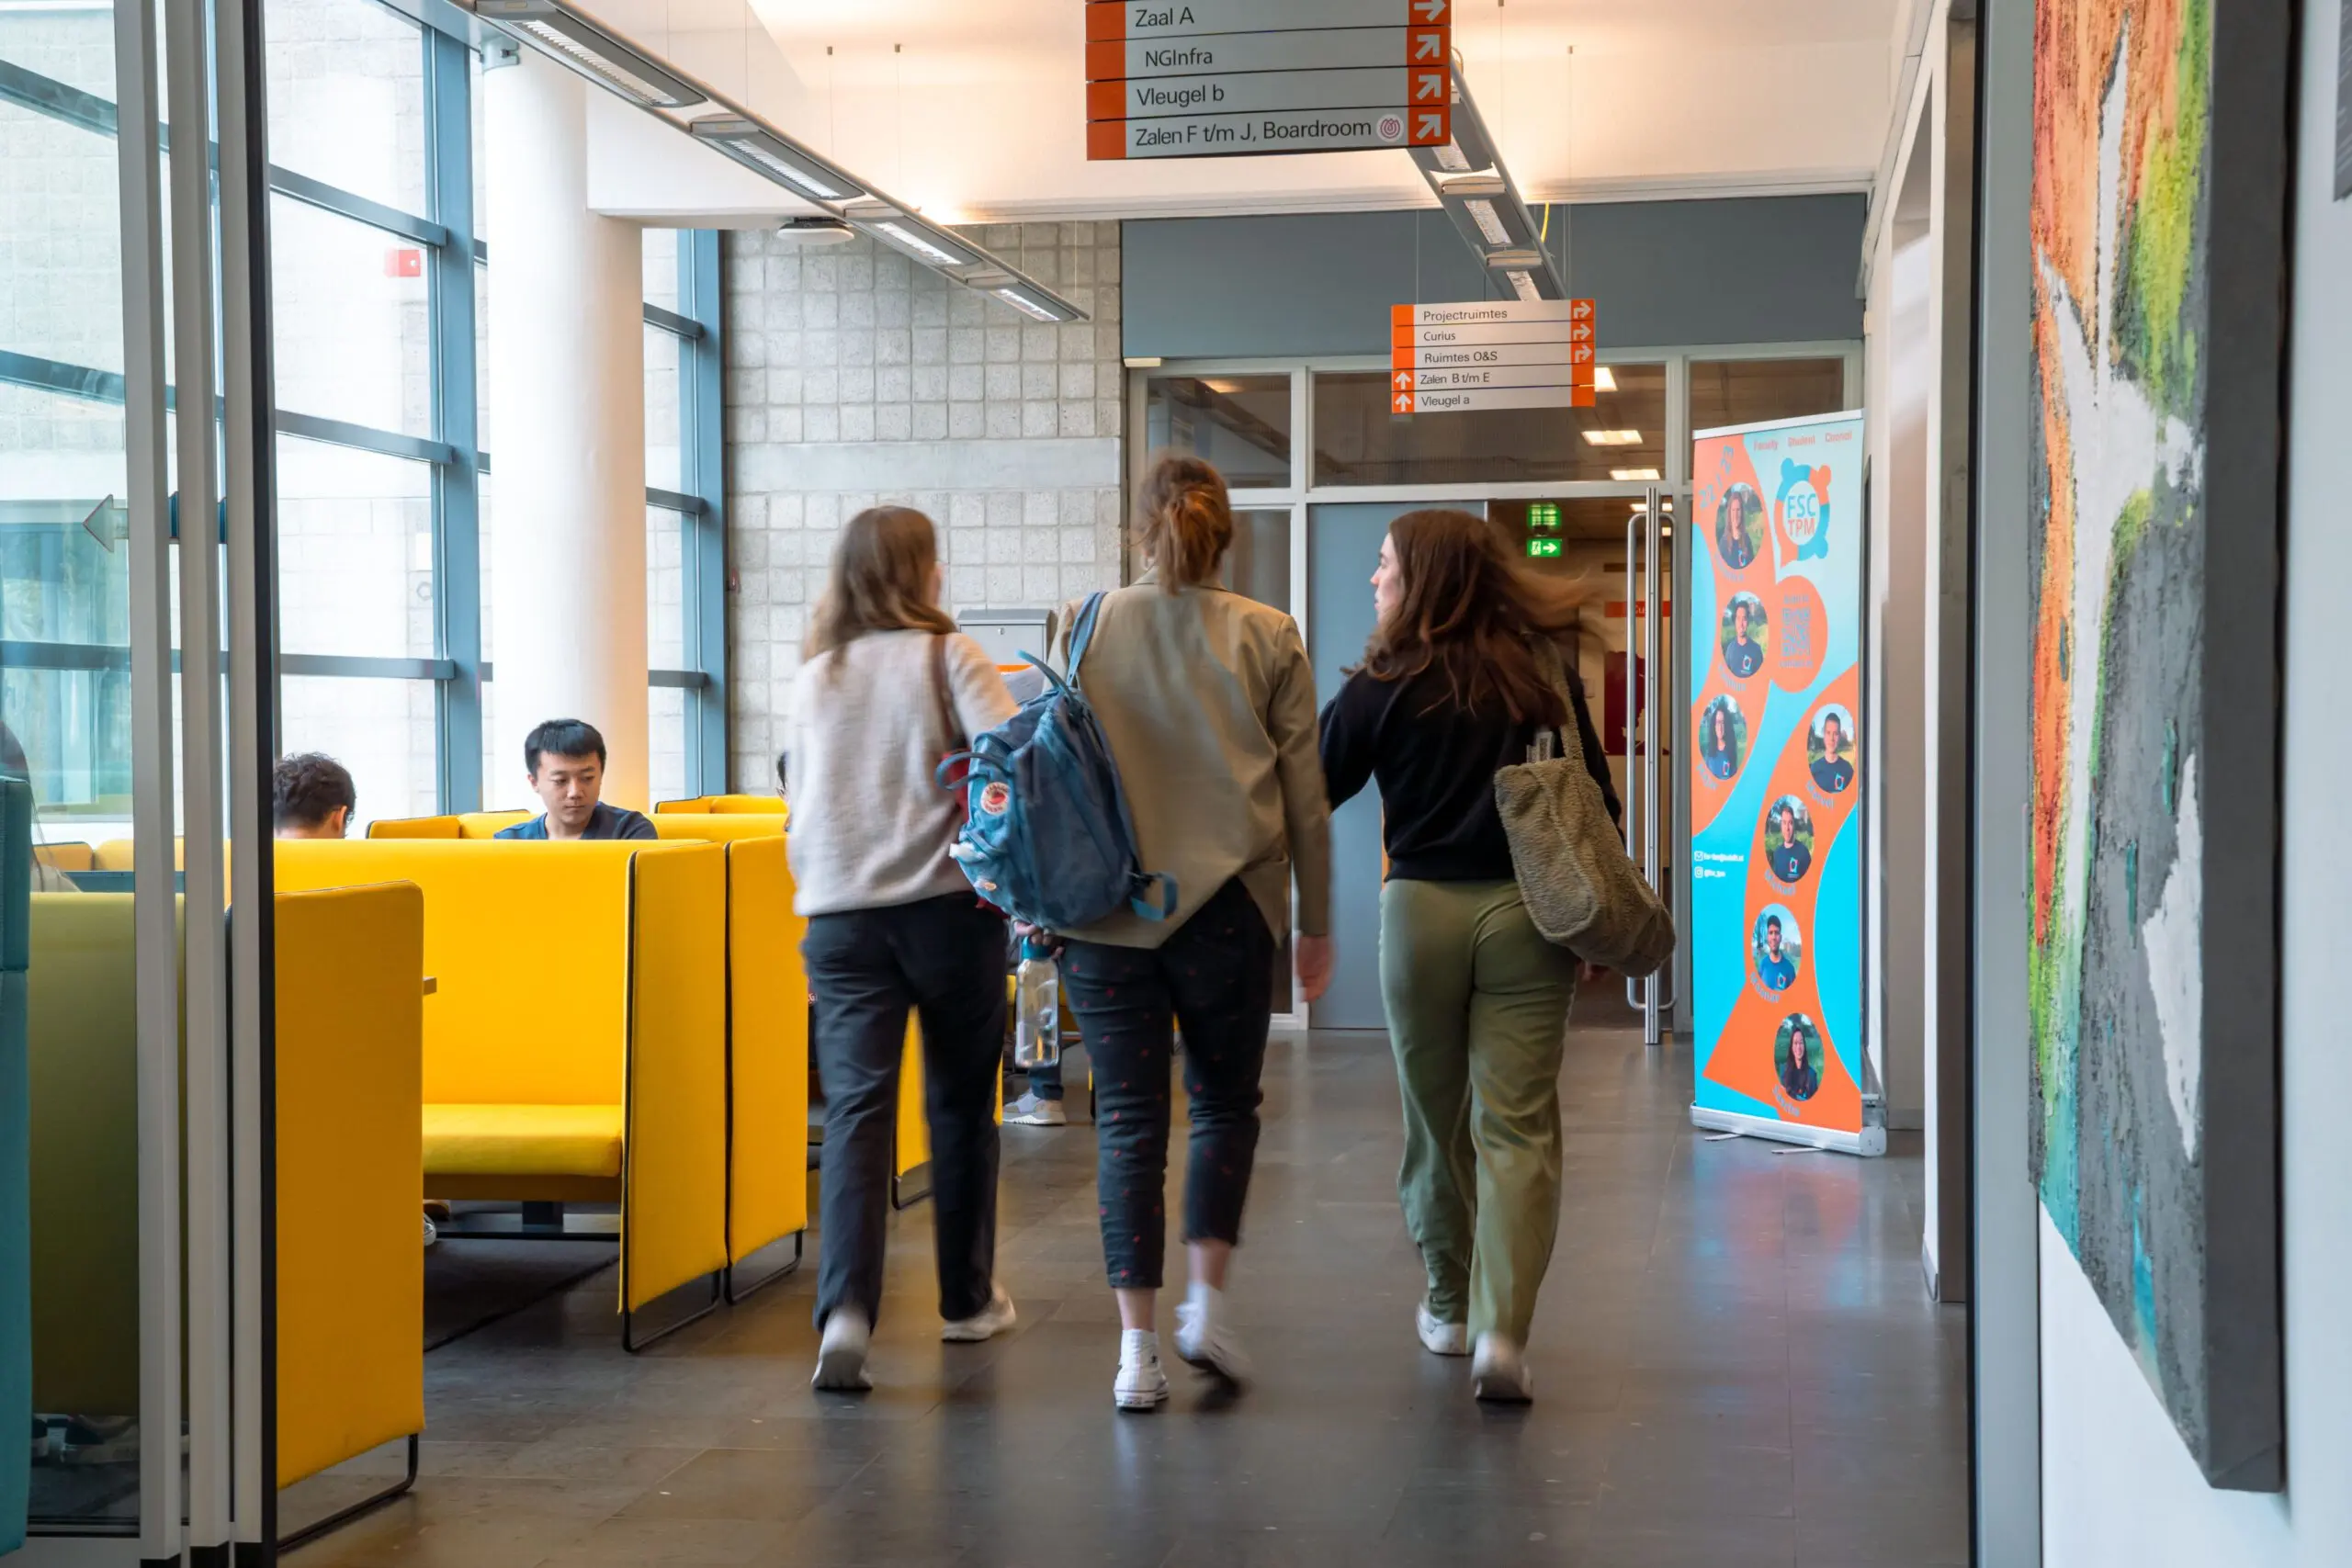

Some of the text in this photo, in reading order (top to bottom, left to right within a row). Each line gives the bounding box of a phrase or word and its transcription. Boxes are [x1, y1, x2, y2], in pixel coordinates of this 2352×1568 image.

[1135, 6, 1195, 28] Zaal A
[1145, 47, 1213, 68] NGInfra
[1136, 84, 1225, 108] Vleugel b
[1136, 119, 1372, 147] Zalen F t/m J, Boardroom
[1423, 309, 1508, 322] Projectruimtes
[1423, 331, 1456, 342] Curius
[1424, 351, 1498, 364] Ruimtes O&S
[1420, 372, 1490, 385] Zalen B t/m E
[1421, 394, 1470, 408] Vleugel a
[1787, 493, 1816, 518] FSC
[1787, 518, 1815, 536] TPM
